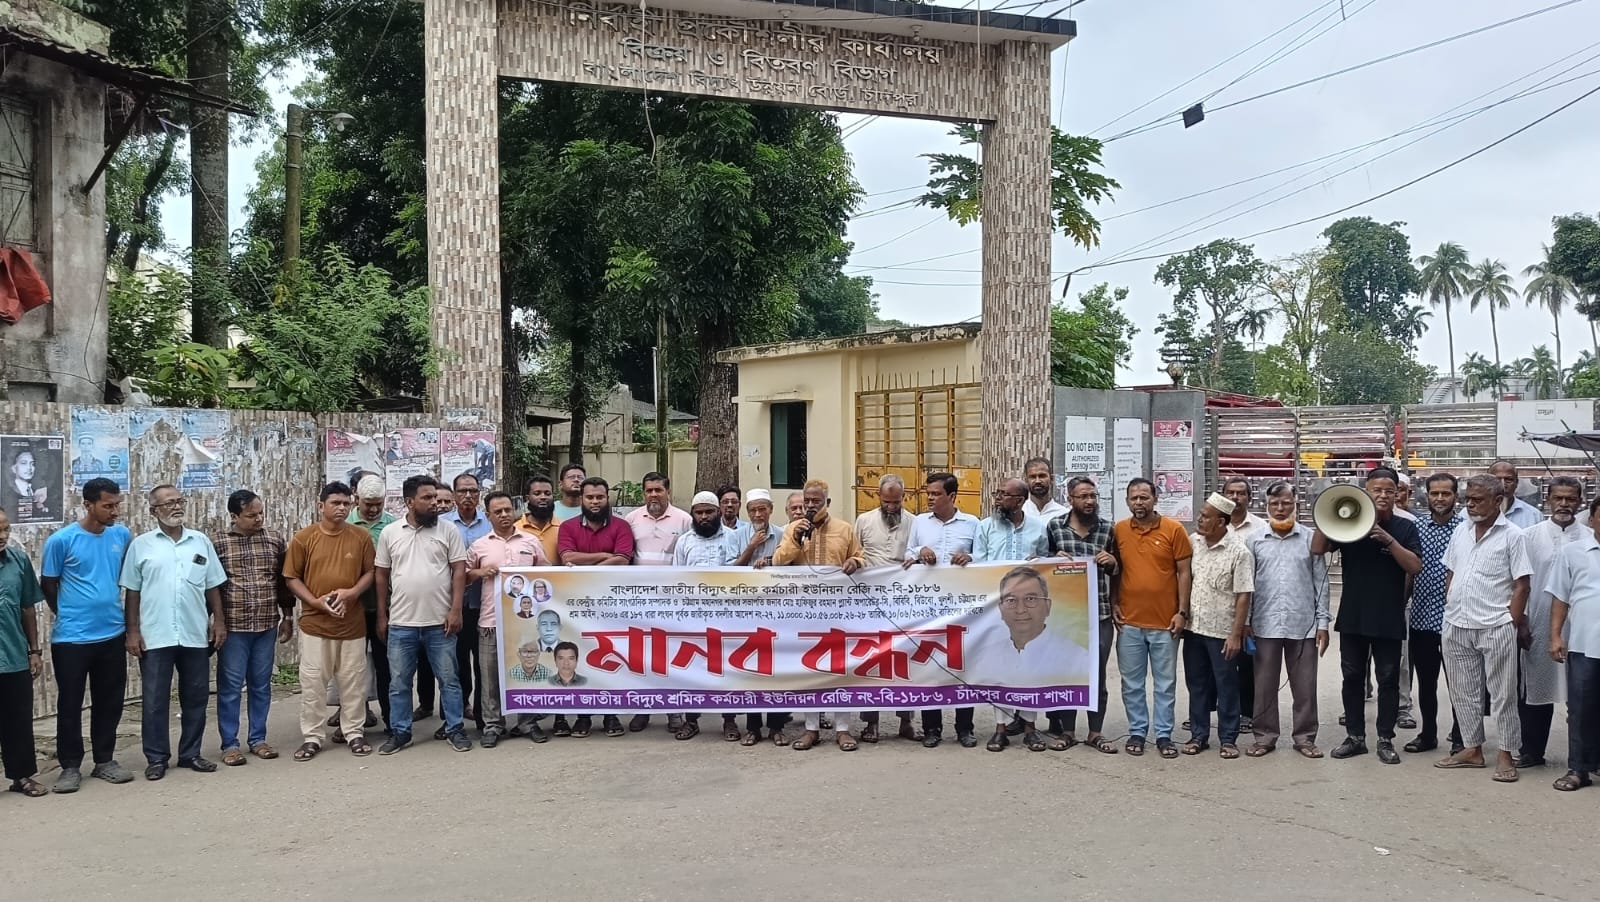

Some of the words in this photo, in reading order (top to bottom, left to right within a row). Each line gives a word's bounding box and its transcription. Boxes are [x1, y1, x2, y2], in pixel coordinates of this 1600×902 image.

[677, 18, 828, 53] প্রকৌশলীর
[838, 33, 944, 65] কার্যালয়
[618, 36, 692, 63] বিক্রয়
[706, 50, 726, 66] ও
[741, 48, 818, 76] বিতরণ
[831, 58, 898, 84] বিভাগ
[583, 62, 682, 86] বাংলাদেশ
[688, 69, 741, 93] বিদ্যুৎ
[746, 76, 802, 98] উন্নয়ন
[1066, 442, 1075, 452] DO
[1076, 442, 1087, 452] NOT
[1088, 442, 1105, 452] ENTER
[609, 584, 658, 595] বাংলাদেশ
[661, 582, 695, 595] জাতীয়
[698, 582, 727, 597] বিদ্যুৎ
[730, 583, 759, 597] শ্রমিক
[761, 583, 799, 596] কর্মচারী
[802, 582, 843, 596] ইউনিয়ন
[847, 582, 872, 595] রেজি
[875, 581, 941, 594] নং-বি-১৮৮৬
[566, 598, 575, 606] এর
[597, 596, 618, 607] কমিটির
[673, 598, 678, 606] ও
[724, 598, 740, 607] শাখার
[742, 596, 765, 607] সভাপতি
[766, 598, 781, 607] জনাব
[819, 598, 837, 607] রহমান
[600, 611, 618, 619] ২০০৬
[619, 610, 629, 619] এর
[630, 611, 643, 619] ১৮৭
[644, 610, 656, 619] ধারা
[734, 610, 754, 619] আদেশ
[581, 626, 777, 677] মানব
[797, 624, 968, 681] বন্ধন
[512, 692, 576, 706] বাংলাদেশ
[579, 690, 622, 706] জাতীয়
[626, 690, 665, 708] বিদ্যুৎ
[667, 691, 705, 707] শ্রমিক
[710, 691, 758, 705] কর্মচারী
[762, 690, 816, 705] ইউনিয়ন
[821, 688, 852, 704] রেজি
[955, 685, 1000, 703] চাঁদপুর
[1005, 691, 1040, 705] জেলা
[1044, 689, 1075, 702] শাখা
